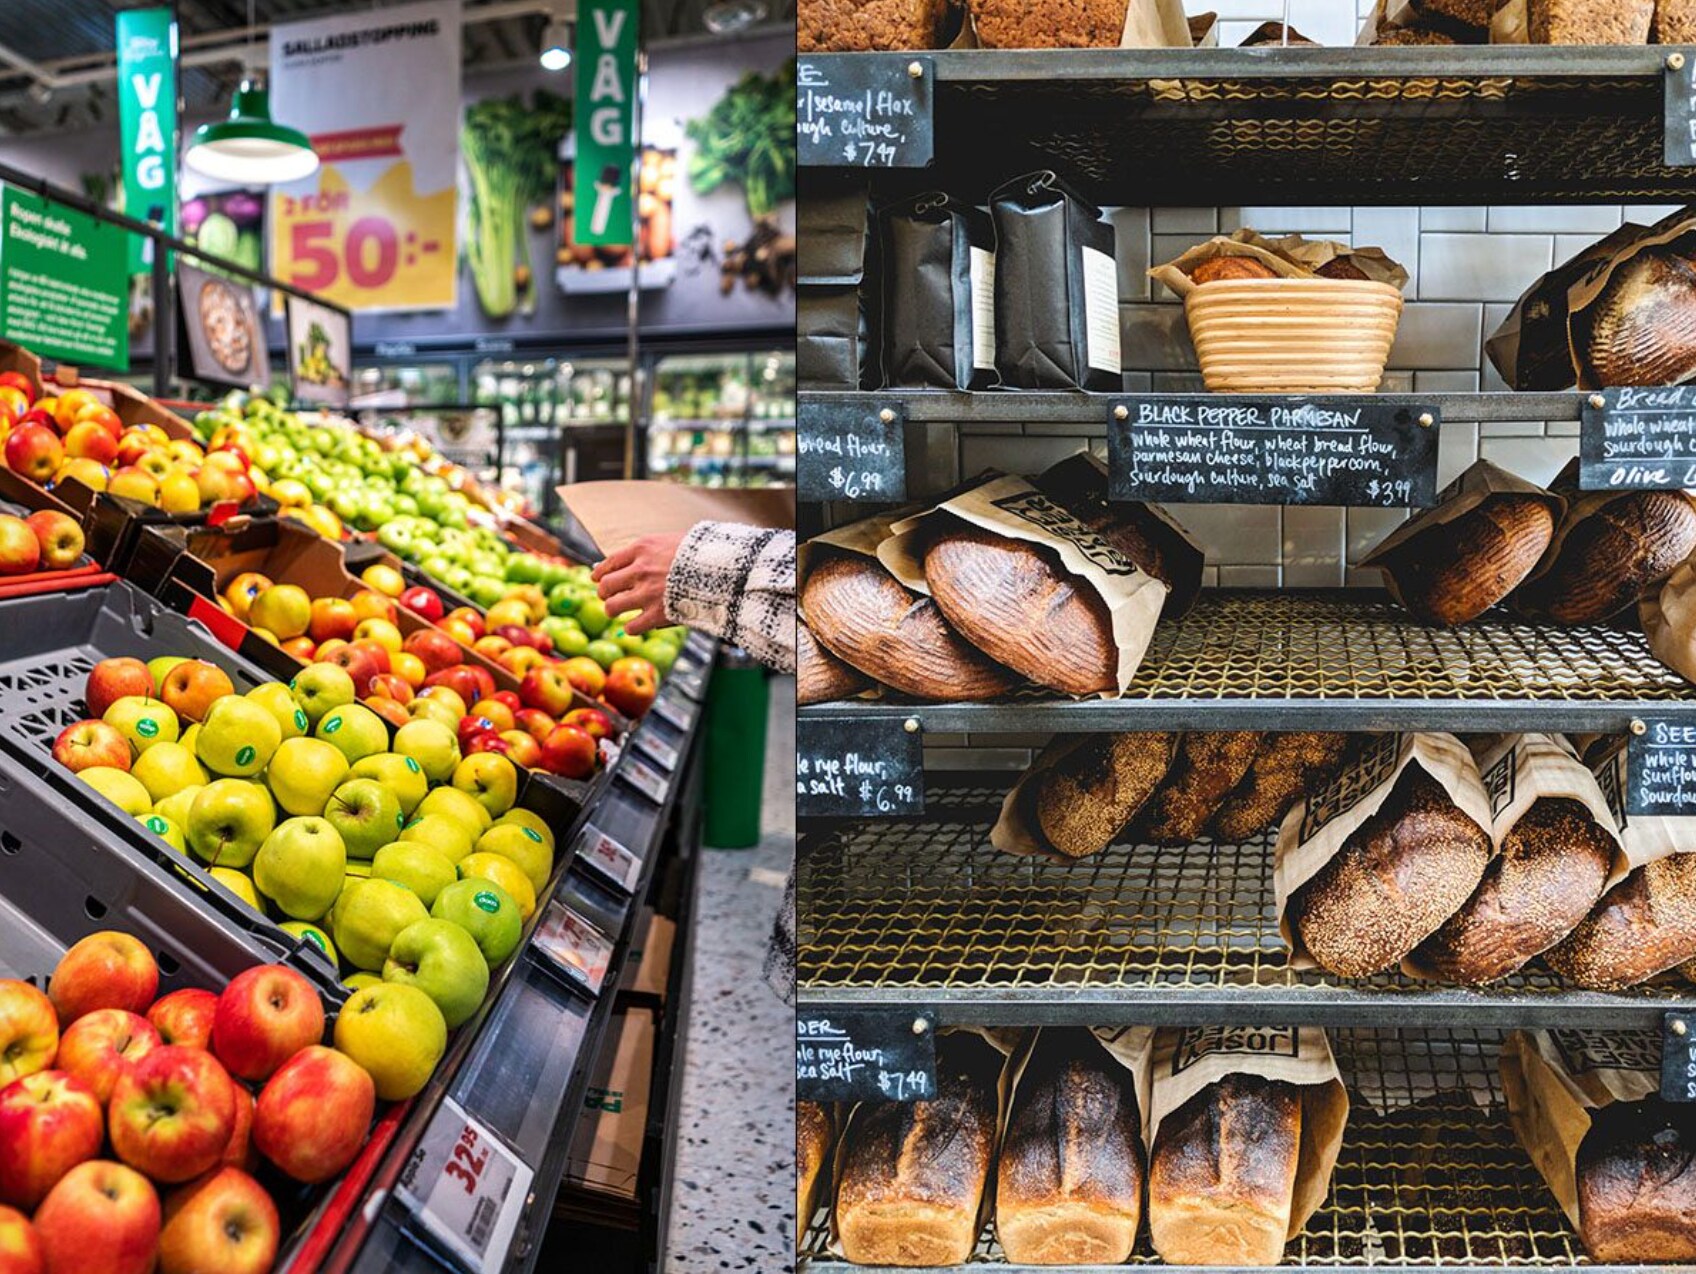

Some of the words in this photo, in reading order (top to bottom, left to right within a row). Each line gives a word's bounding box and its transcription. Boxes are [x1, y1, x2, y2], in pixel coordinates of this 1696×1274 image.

[1138, 404, 1194, 425] BLACK
[1198, 406, 1266, 428] PEPPER
[1271, 407, 1362, 429] PARMESAN
[797, 433, 843, 455] bread
[847, 432, 890, 458] flour,
[1175, 430, 1217, 449] wheat
[1221, 429, 1259, 455] flour,
[1265, 434, 1307, 453] wheat
[1314, 435, 1353, 453] bread
[1358, 434, 1397, 460] flour,
[1133, 451, 1201, 473] parmesan
[1206, 449, 1259, 468] cheese,
[828, 466, 881, 499] $6.99
[1267, 473, 1290, 488] sea
[814, 759, 840, 780] rye
[843, 752, 886, 780] flour,
[859, 779, 913, 812] $6.99
[818, 1047, 840, 1066] rye
[877, 1070, 927, 1100] $7.49
